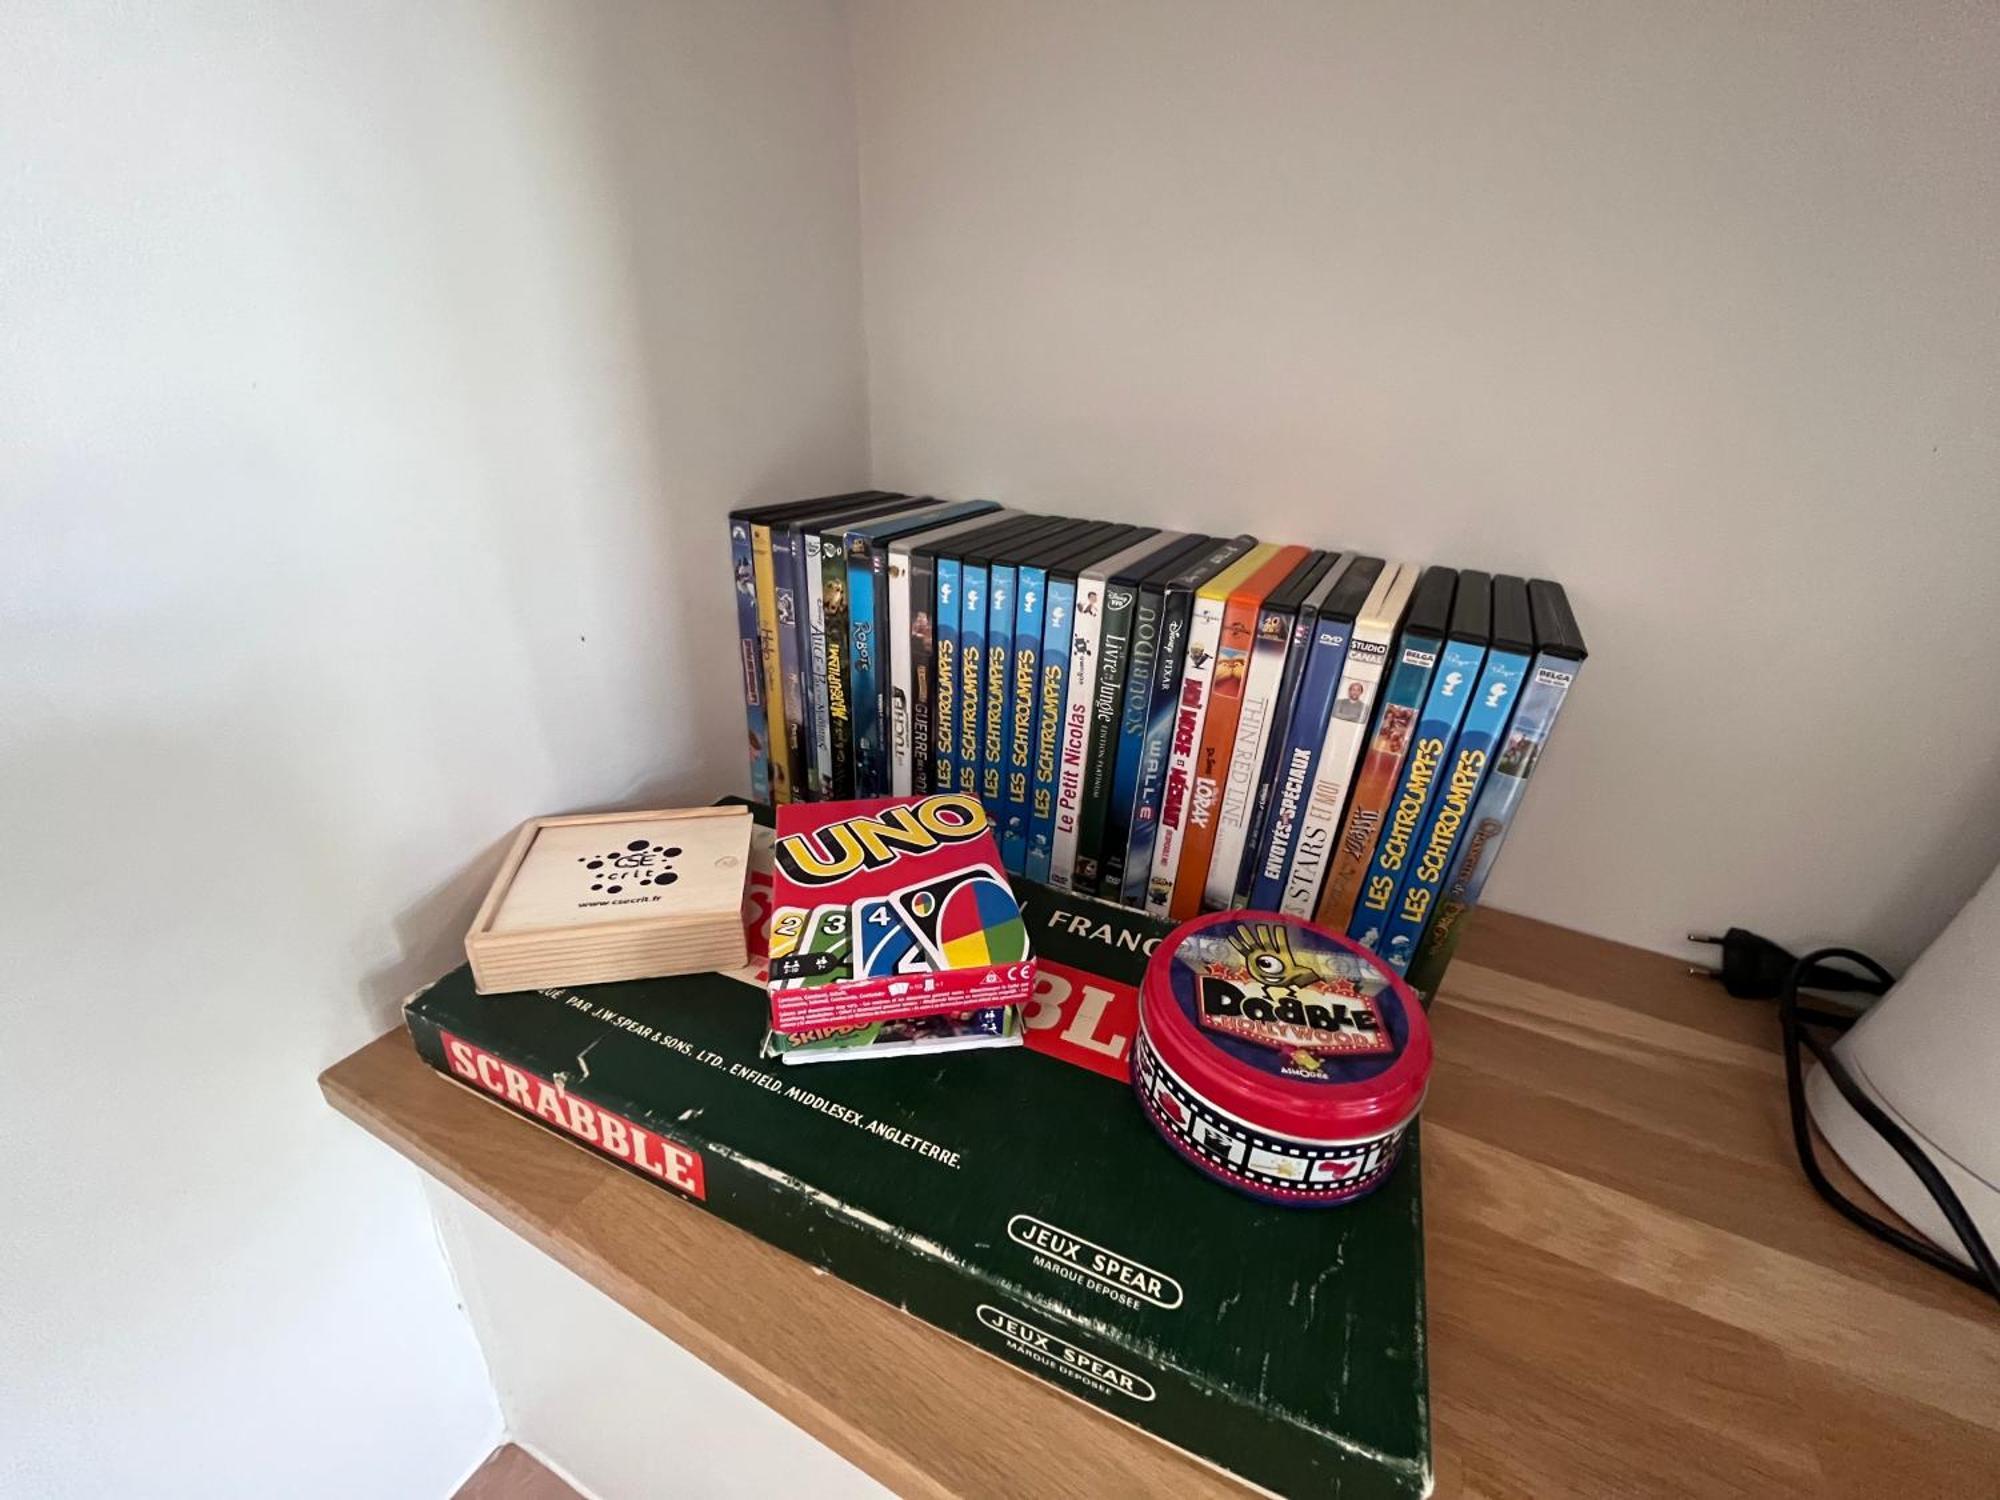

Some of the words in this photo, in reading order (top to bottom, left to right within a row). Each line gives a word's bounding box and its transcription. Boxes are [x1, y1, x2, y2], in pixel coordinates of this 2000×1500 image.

[1351, 641, 1386, 654] STUDIO
[1406, 650, 1434, 662] BELGA
[1539, 670, 1570, 682] BELGA
[938, 639, 953, 753] SCHTROUMPFS
[962, 646, 979, 762] SCHTROUMPFS
[985, 646, 1005, 763] SCHTROUMPFS
[1012, 649, 1035, 768] SCHTROUMPFS
[914, 704, 928, 760] GUERRE
[1037, 665, 1062, 783] SCHTROUMPFS
[1064, 704, 1086, 767] Nicolas
[937, 758, 951, 789] LES
[960, 767, 976, 795] LES
[984, 768, 999, 798] LES
[1232, 749, 1253, 784] RED
[1010, 772, 1025, 803] LES
[1034, 788, 1050, 819] LES
[1060, 769, 1079, 811] Petit
[1314, 779, 1342, 804] MOI
[1058, 815, 1073, 833] Le
[1222, 788, 1246, 828] LINE
[1264, 819, 1293, 881] ENVOYÉS
[1279, 747, 1312, 820] SPÉCIAUX
[1309, 804, 1333, 822] ET
[1365, 875, 1394, 911] LES
[1380, 738, 1444, 871] SCHTROUMPFS
[776, 795, 989, 887] UNO
[1401, 887, 1431, 923] LES
[1416, 749, 1486, 884] SCHTROUMPFS
[614, 853, 657, 868] CSE
[1289, 825, 1328, 902] STARS
[774, 916, 802, 937] 2
[823, 914, 846, 935] 3
[869, 906, 891, 926] 4
[1048, 909, 1163, 959] FRANC
[1219, 1015, 1370, 1047] HOLLYWOOD
[566, 996, 593, 1012] PAR
[651, 1032, 663, 1043] &
[864, 1119, 962, 1170] ANGLETERRE.
[450, 1040, 696, 1193] SCRABBLE
[1022, 1225, 1081, 1261] JEUX
[1092, 1254, 1162, 1299] SPEAR
[1032, 1255, 1085, 1285] MARQUE
[991, 1316, 1049, 1350] JEUX
[1063, 1348, 1134, 1391] SPEAR
[1006, 1339, 1057, 1369] MARQUE
